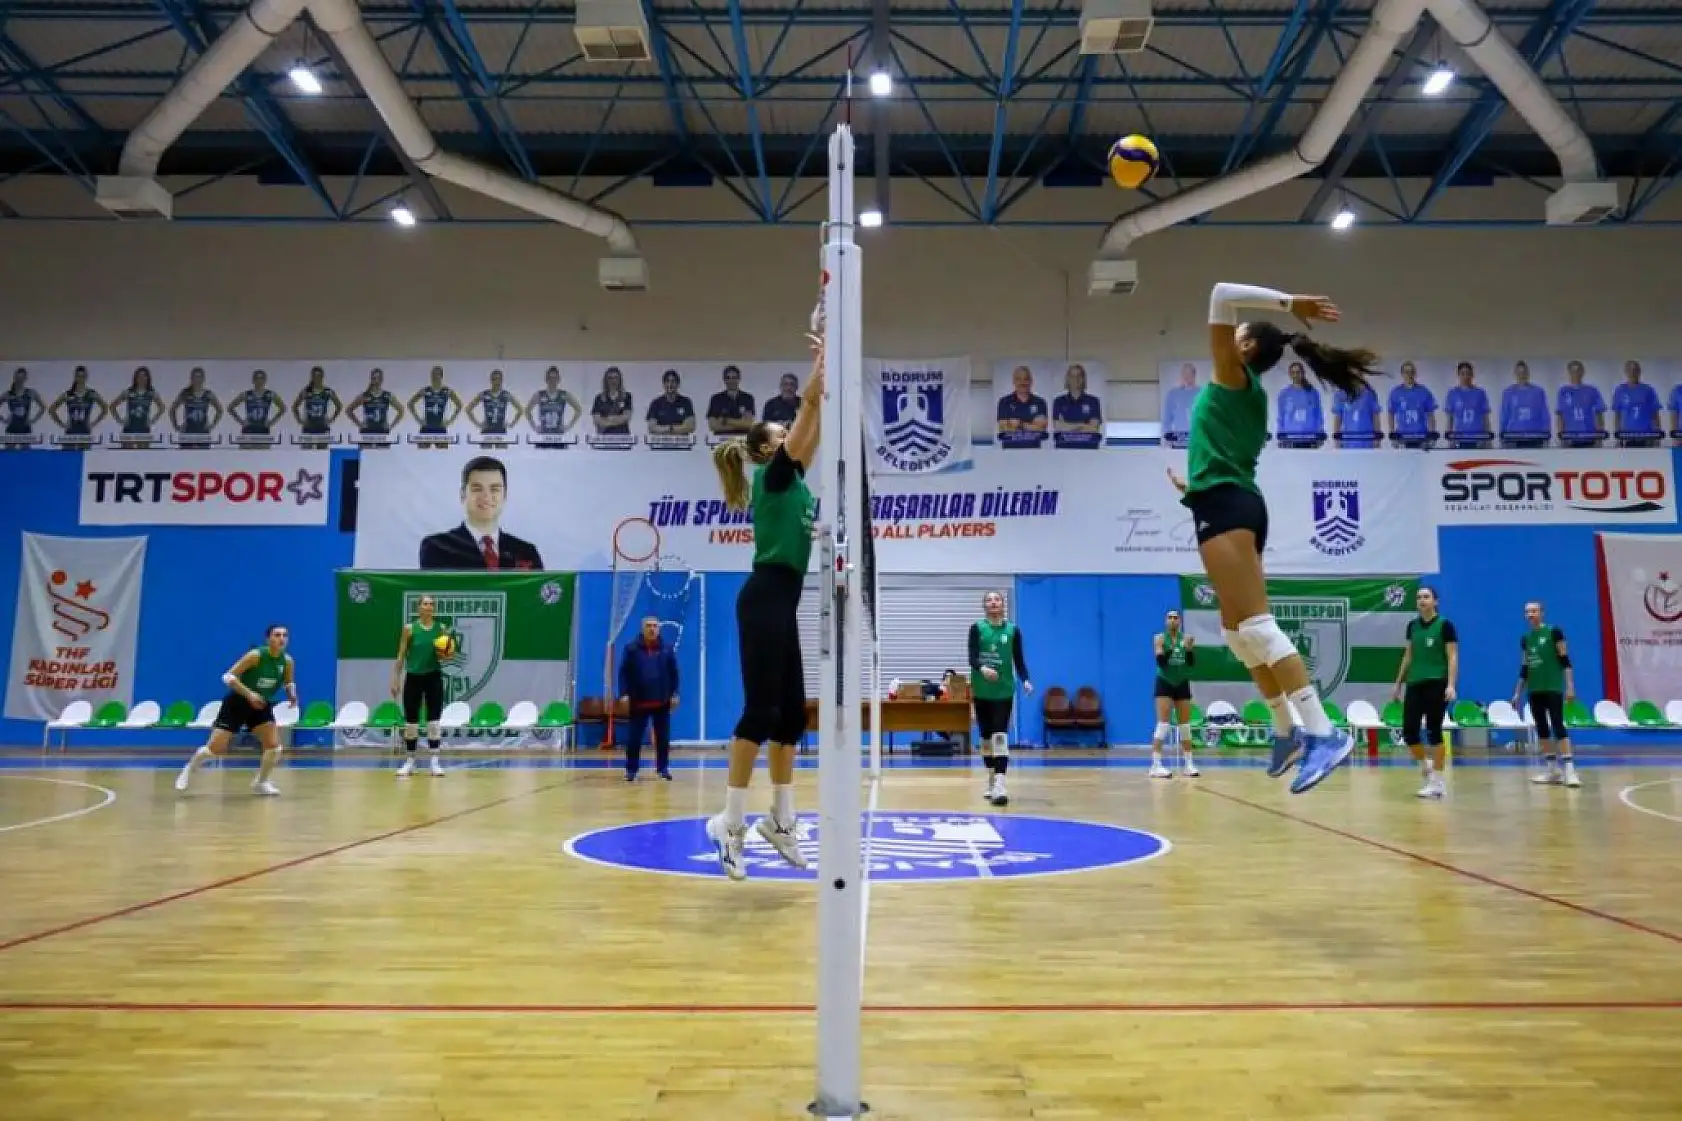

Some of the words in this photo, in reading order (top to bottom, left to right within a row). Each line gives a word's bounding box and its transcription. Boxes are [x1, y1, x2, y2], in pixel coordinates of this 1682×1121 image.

[880, 370, 943, 382] BODRUM
[1312, 480, 1358, 488] BODRUM
[649, 495, 689, 526] TÜM
[980, 485, 1059, 517] DİLERİM
[718, 528, 755, 544] WIS
[883, 525, 914, 539] ALL
[917, 522, 996, 539] PLAYERS
[29, 659, 116, 674] KADINLAR
[24, 672, 78, 689] SÜPER
[82, 672, 119, 689] LİGİ
